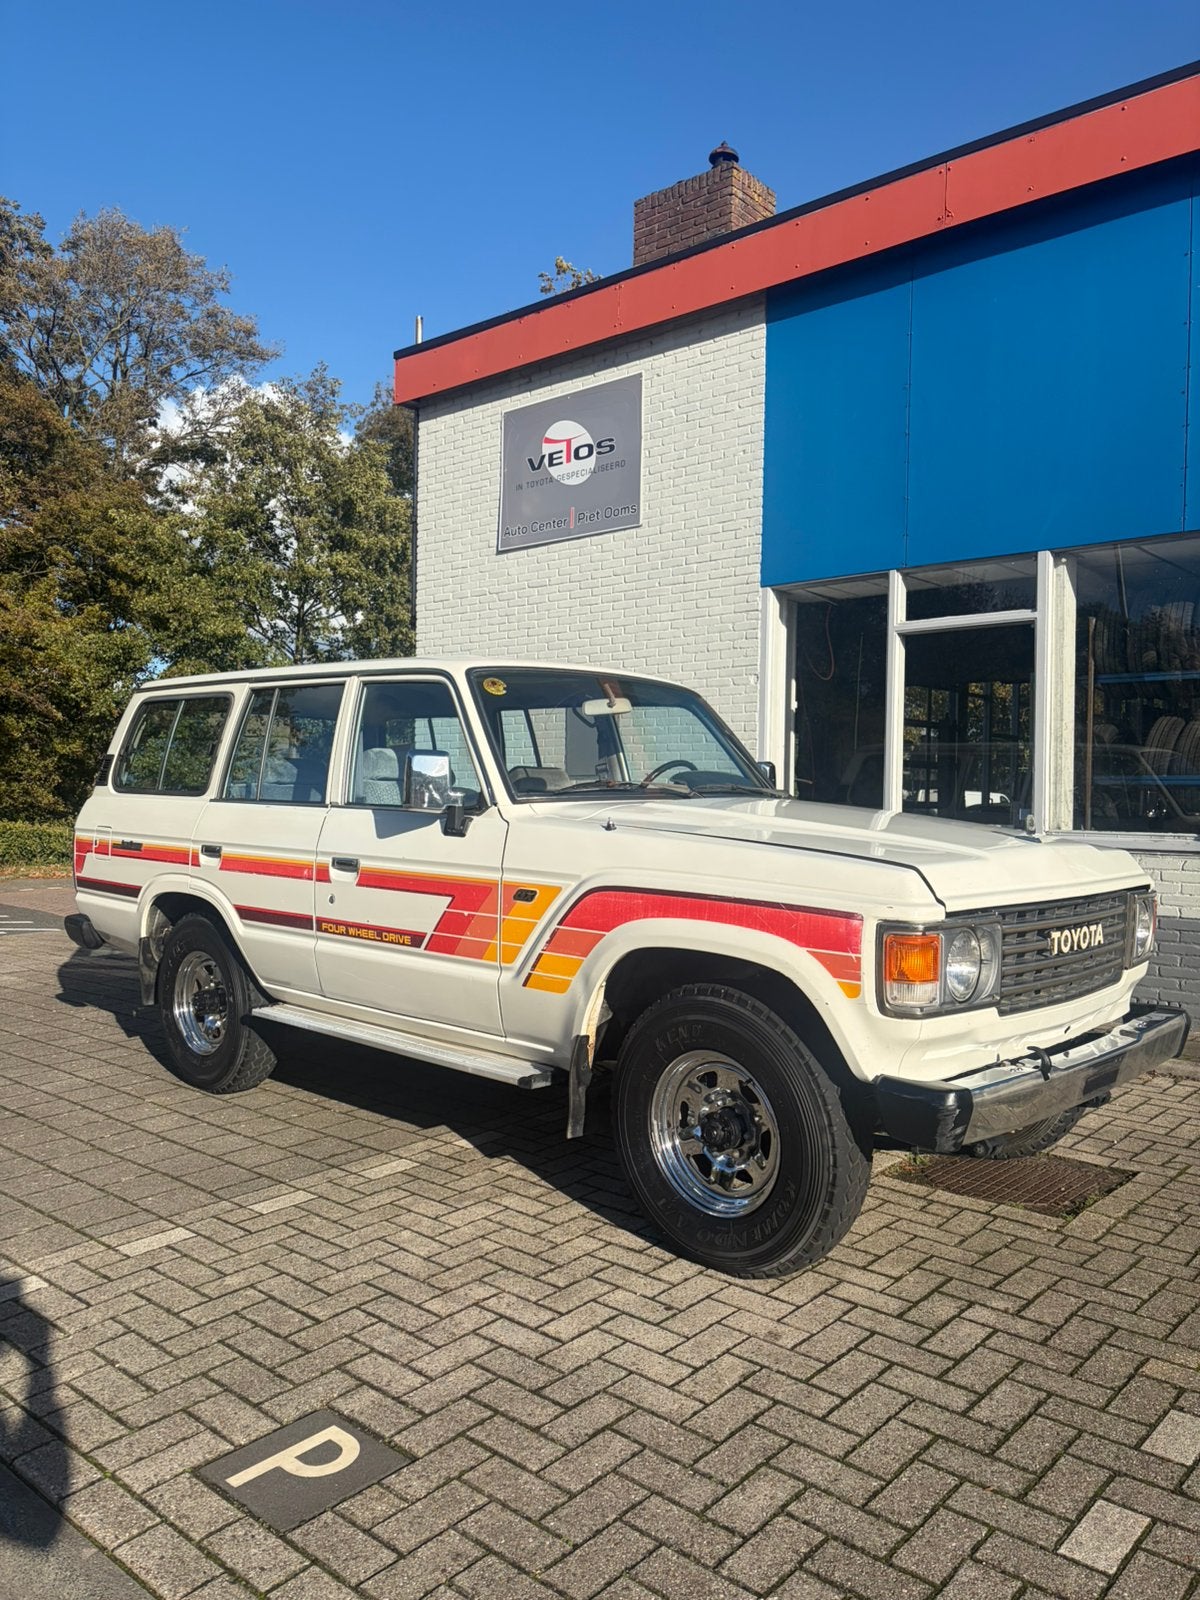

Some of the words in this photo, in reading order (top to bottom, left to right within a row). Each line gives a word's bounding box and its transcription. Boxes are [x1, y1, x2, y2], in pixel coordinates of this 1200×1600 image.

[527, 433, 616, 472] VETOS
[515, 482, 523, 491] IN
[526, 476, 554, 490] TOYOTA
[556, 459, 627, 482] GESPECIALISEERD
[503, 525, 528, 538] Auto
[530, 517, 567, 533] Center
[577, 508, 601, 524] Piet
[604, 503, 637, 519] Ooms
[321, 922, 346, 935] FOUR
[347, 926, 381, 940] WHEEL
[382, 931, 412, 945] DRIVE
[1050, 923, 1104, 956] TOYOTA
[225, 1424, 361, 1489] P
